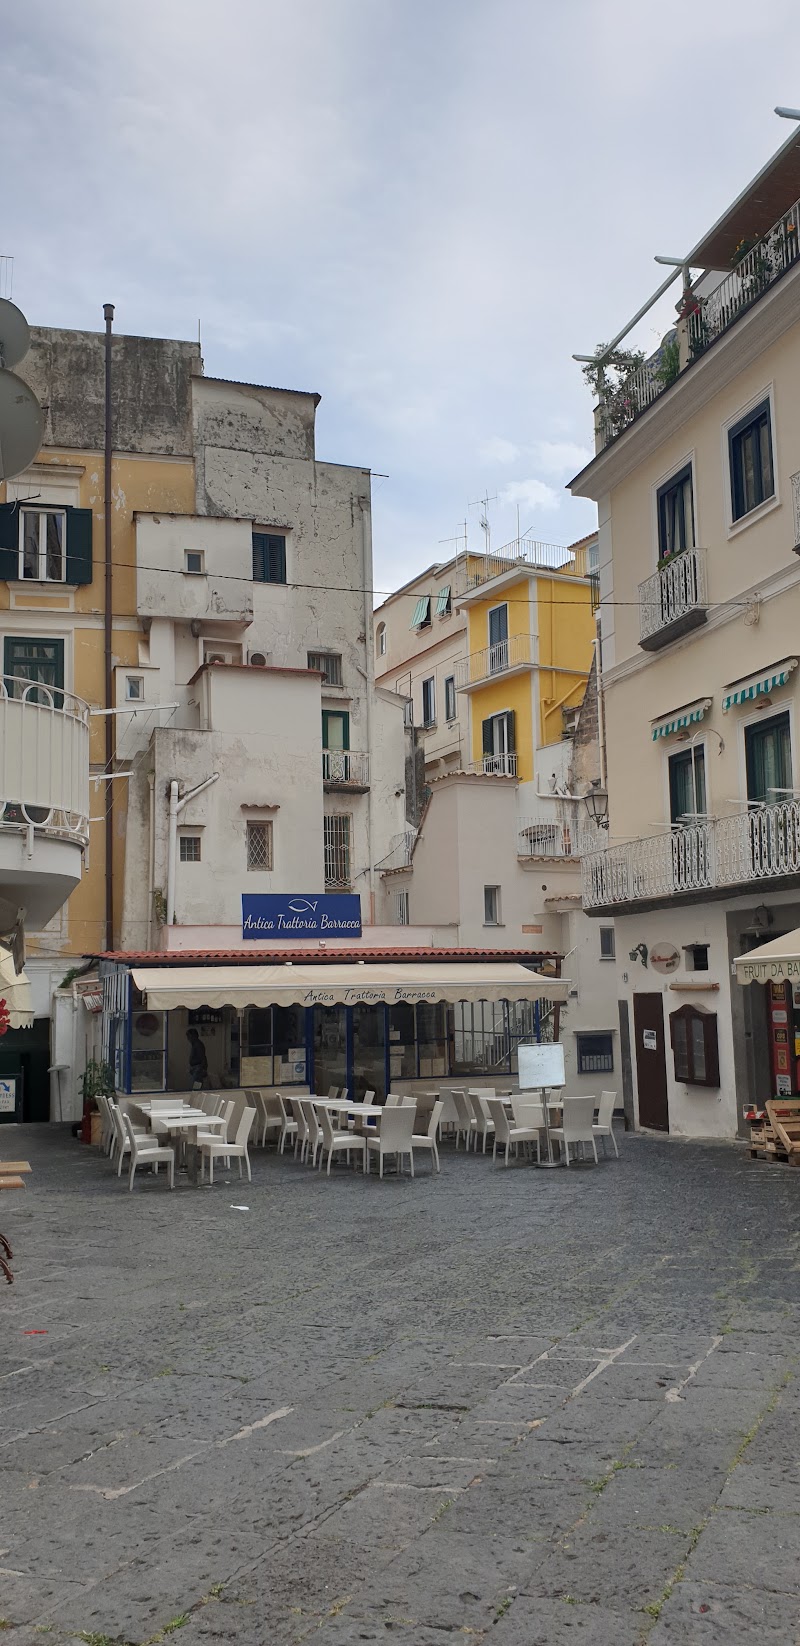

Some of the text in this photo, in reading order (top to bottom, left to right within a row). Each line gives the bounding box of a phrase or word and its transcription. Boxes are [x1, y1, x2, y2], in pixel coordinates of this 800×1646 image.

[243, 914, 361, 930] Antica Trattoria Barracca
[743, 962, 800, 979] FRUIT DA BA
[304, 987, 436, 1002] Antica Trattoria Barracca
